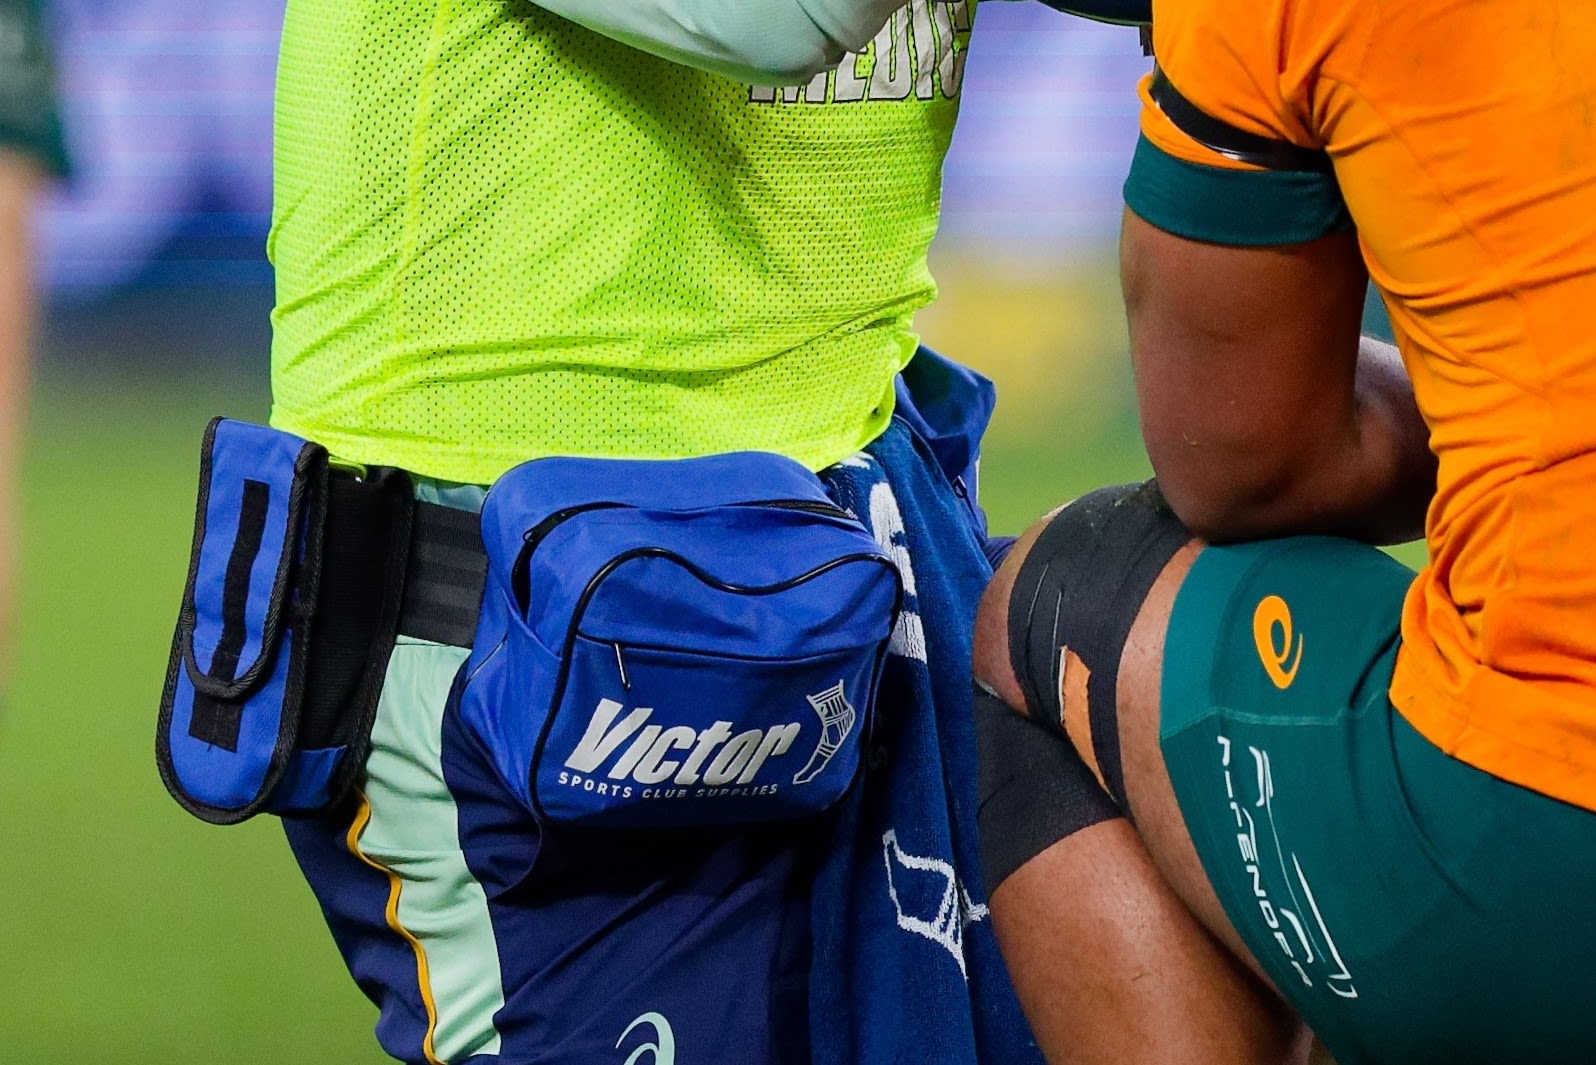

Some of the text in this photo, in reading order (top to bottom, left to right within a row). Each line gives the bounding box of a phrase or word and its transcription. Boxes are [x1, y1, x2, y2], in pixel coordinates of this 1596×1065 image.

[564, 697, 802, 786] Victor
[558, 771, 779, 800] SPORTS CLUB SUPPLIES
